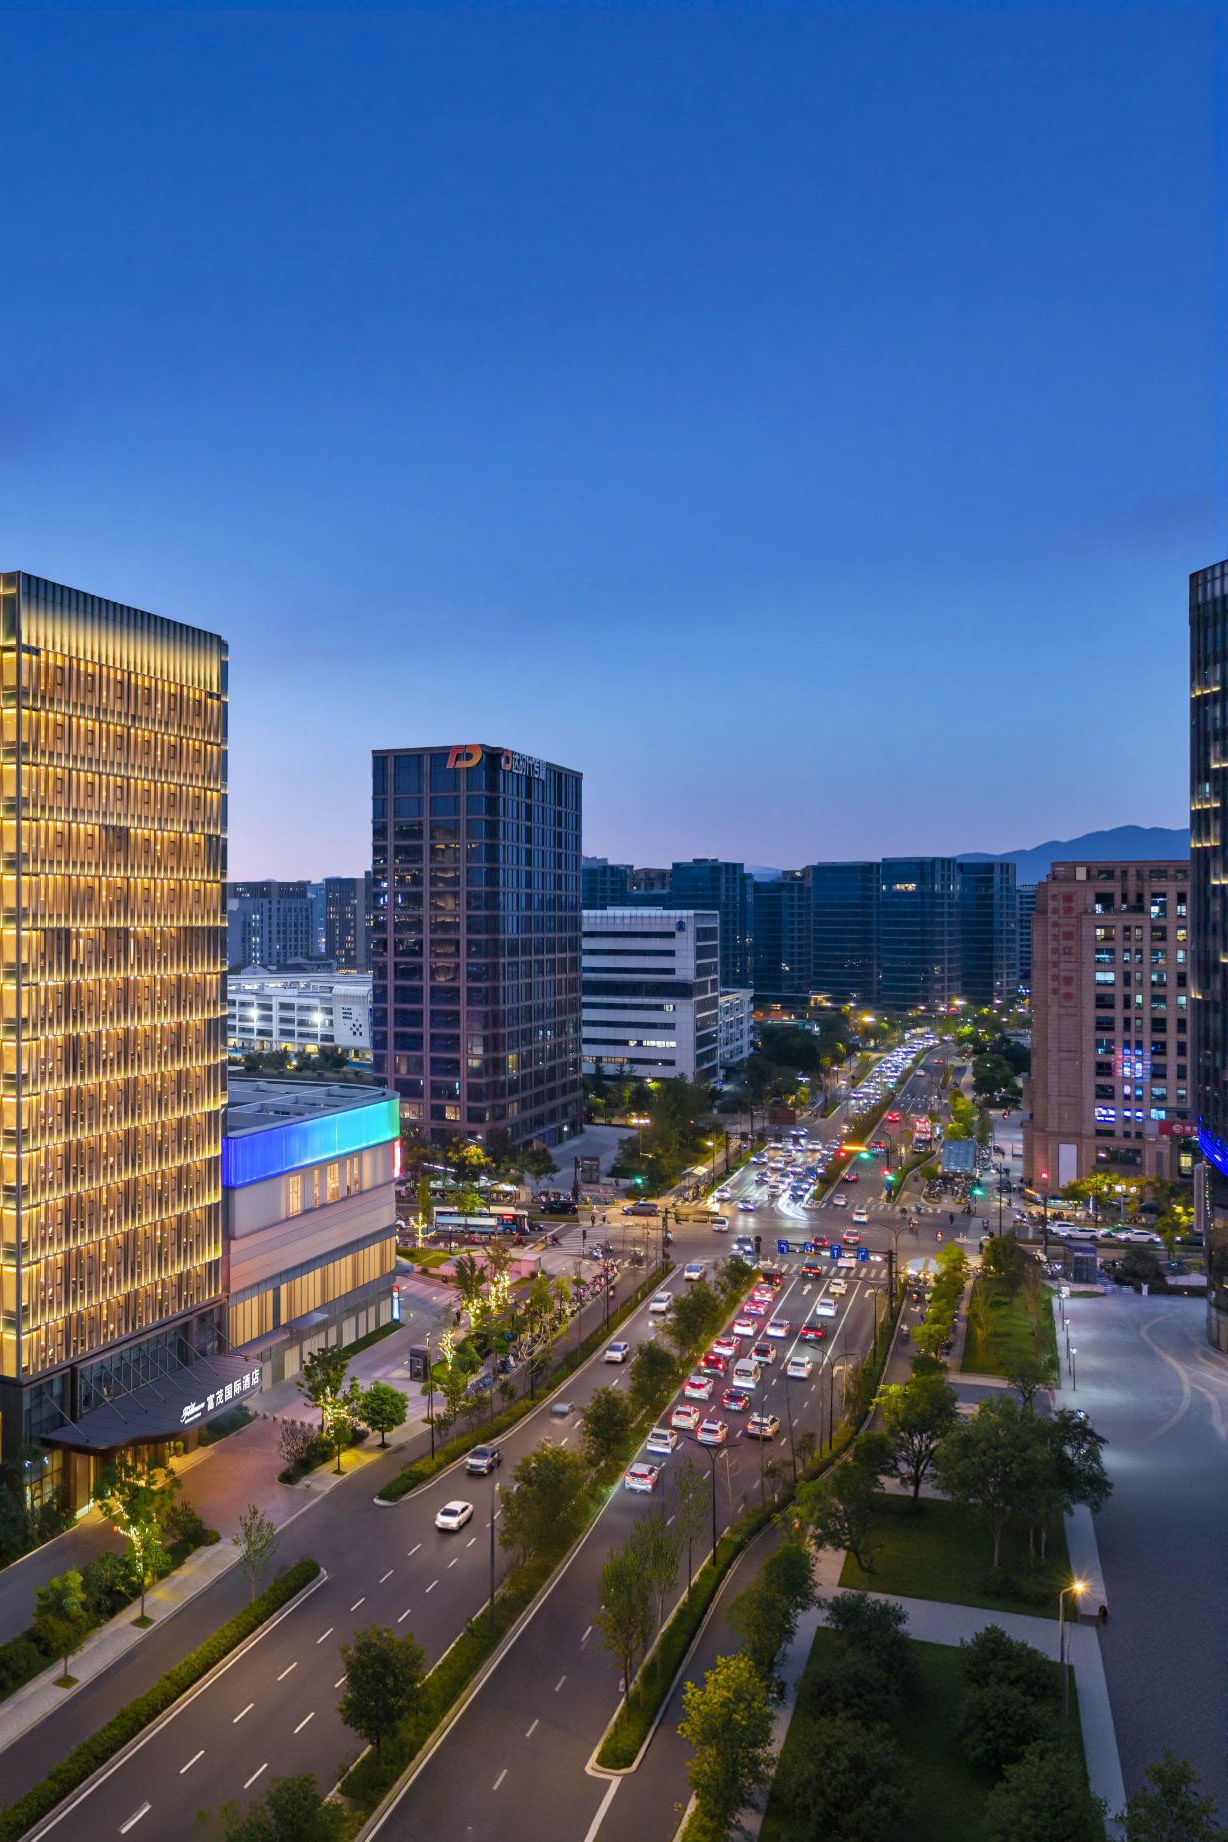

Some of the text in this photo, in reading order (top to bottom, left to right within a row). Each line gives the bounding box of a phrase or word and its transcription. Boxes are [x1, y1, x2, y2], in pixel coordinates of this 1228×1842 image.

[206, 1368, 260, 1412] 富茂国际酒店
